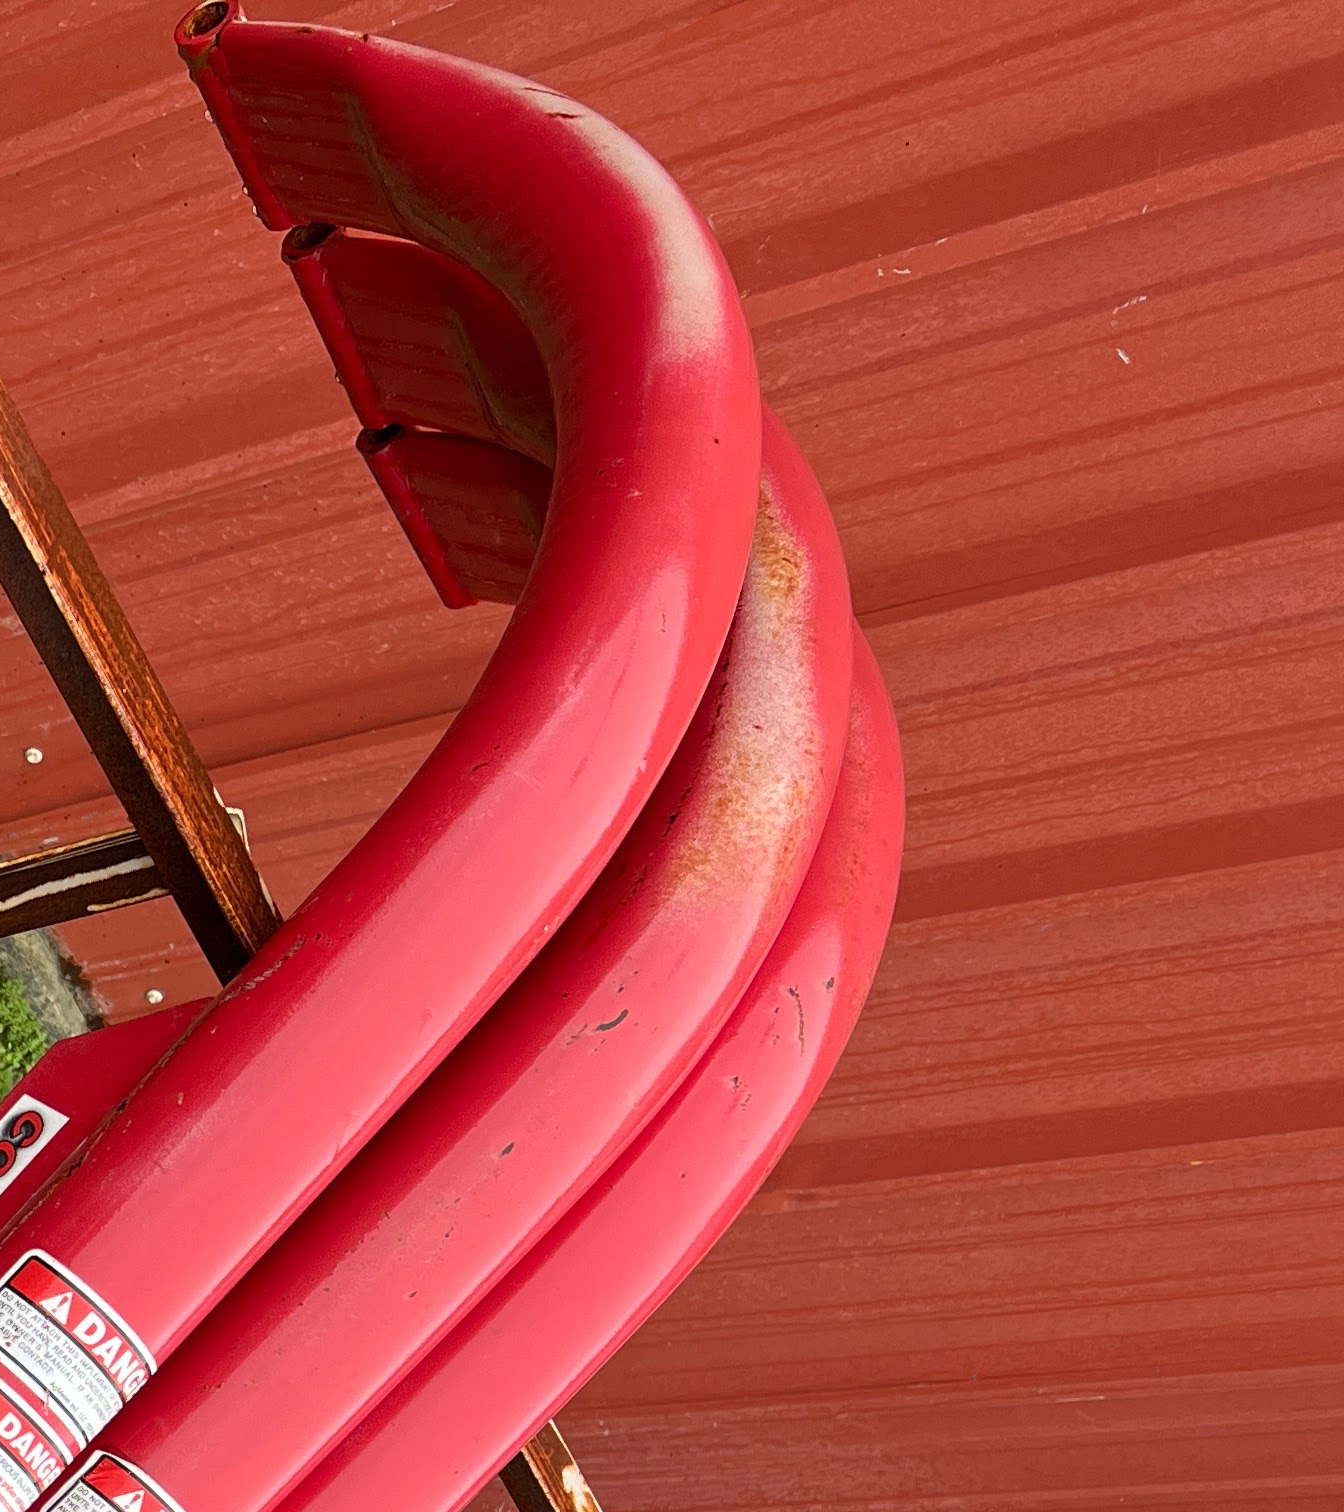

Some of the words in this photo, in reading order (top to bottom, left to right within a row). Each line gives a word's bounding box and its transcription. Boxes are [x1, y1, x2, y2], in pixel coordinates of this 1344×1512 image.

[1, 1289, 14, 1302] DO
[13, 1299, 31, 1316] NOT
[30, 1312, 61, 1342] ATTACH
[60, 1340, 80, 1359] THIS
[4, 1317, 43, 1351] OWNER'S
[14, 1312, 32, 1330] YOU
[31, 1326, 53, 1347] HAVE
[50, 1344, 73, 1366] READ
[70, 1363, 87, 1379] AND
[71, 1309, 147, 1402] DANG
[88, 1493, 105, 1511] NOT
